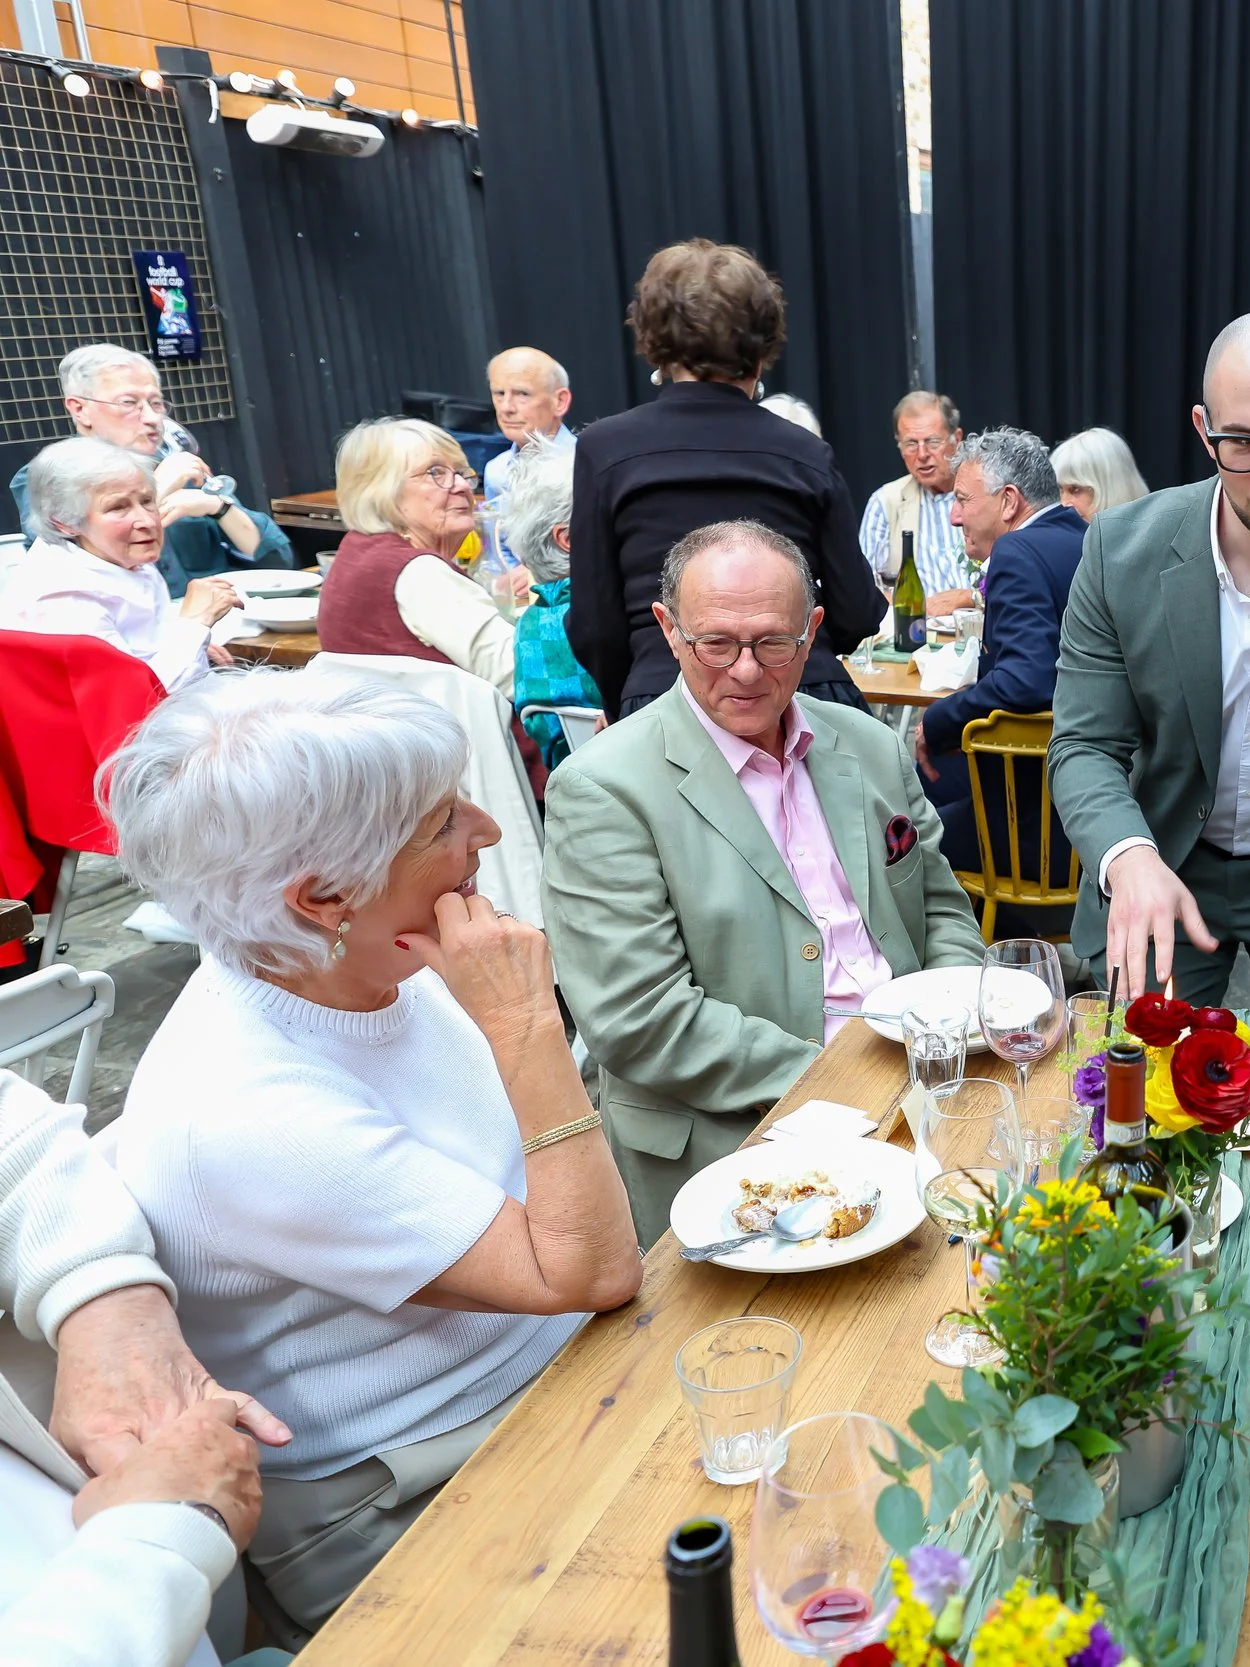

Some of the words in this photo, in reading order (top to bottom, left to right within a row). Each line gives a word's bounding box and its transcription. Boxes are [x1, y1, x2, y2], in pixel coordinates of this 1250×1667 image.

[148, 265, 178, 277] football
[146, 276, 167, 287] world
[168, 277, 185, 288] cup
